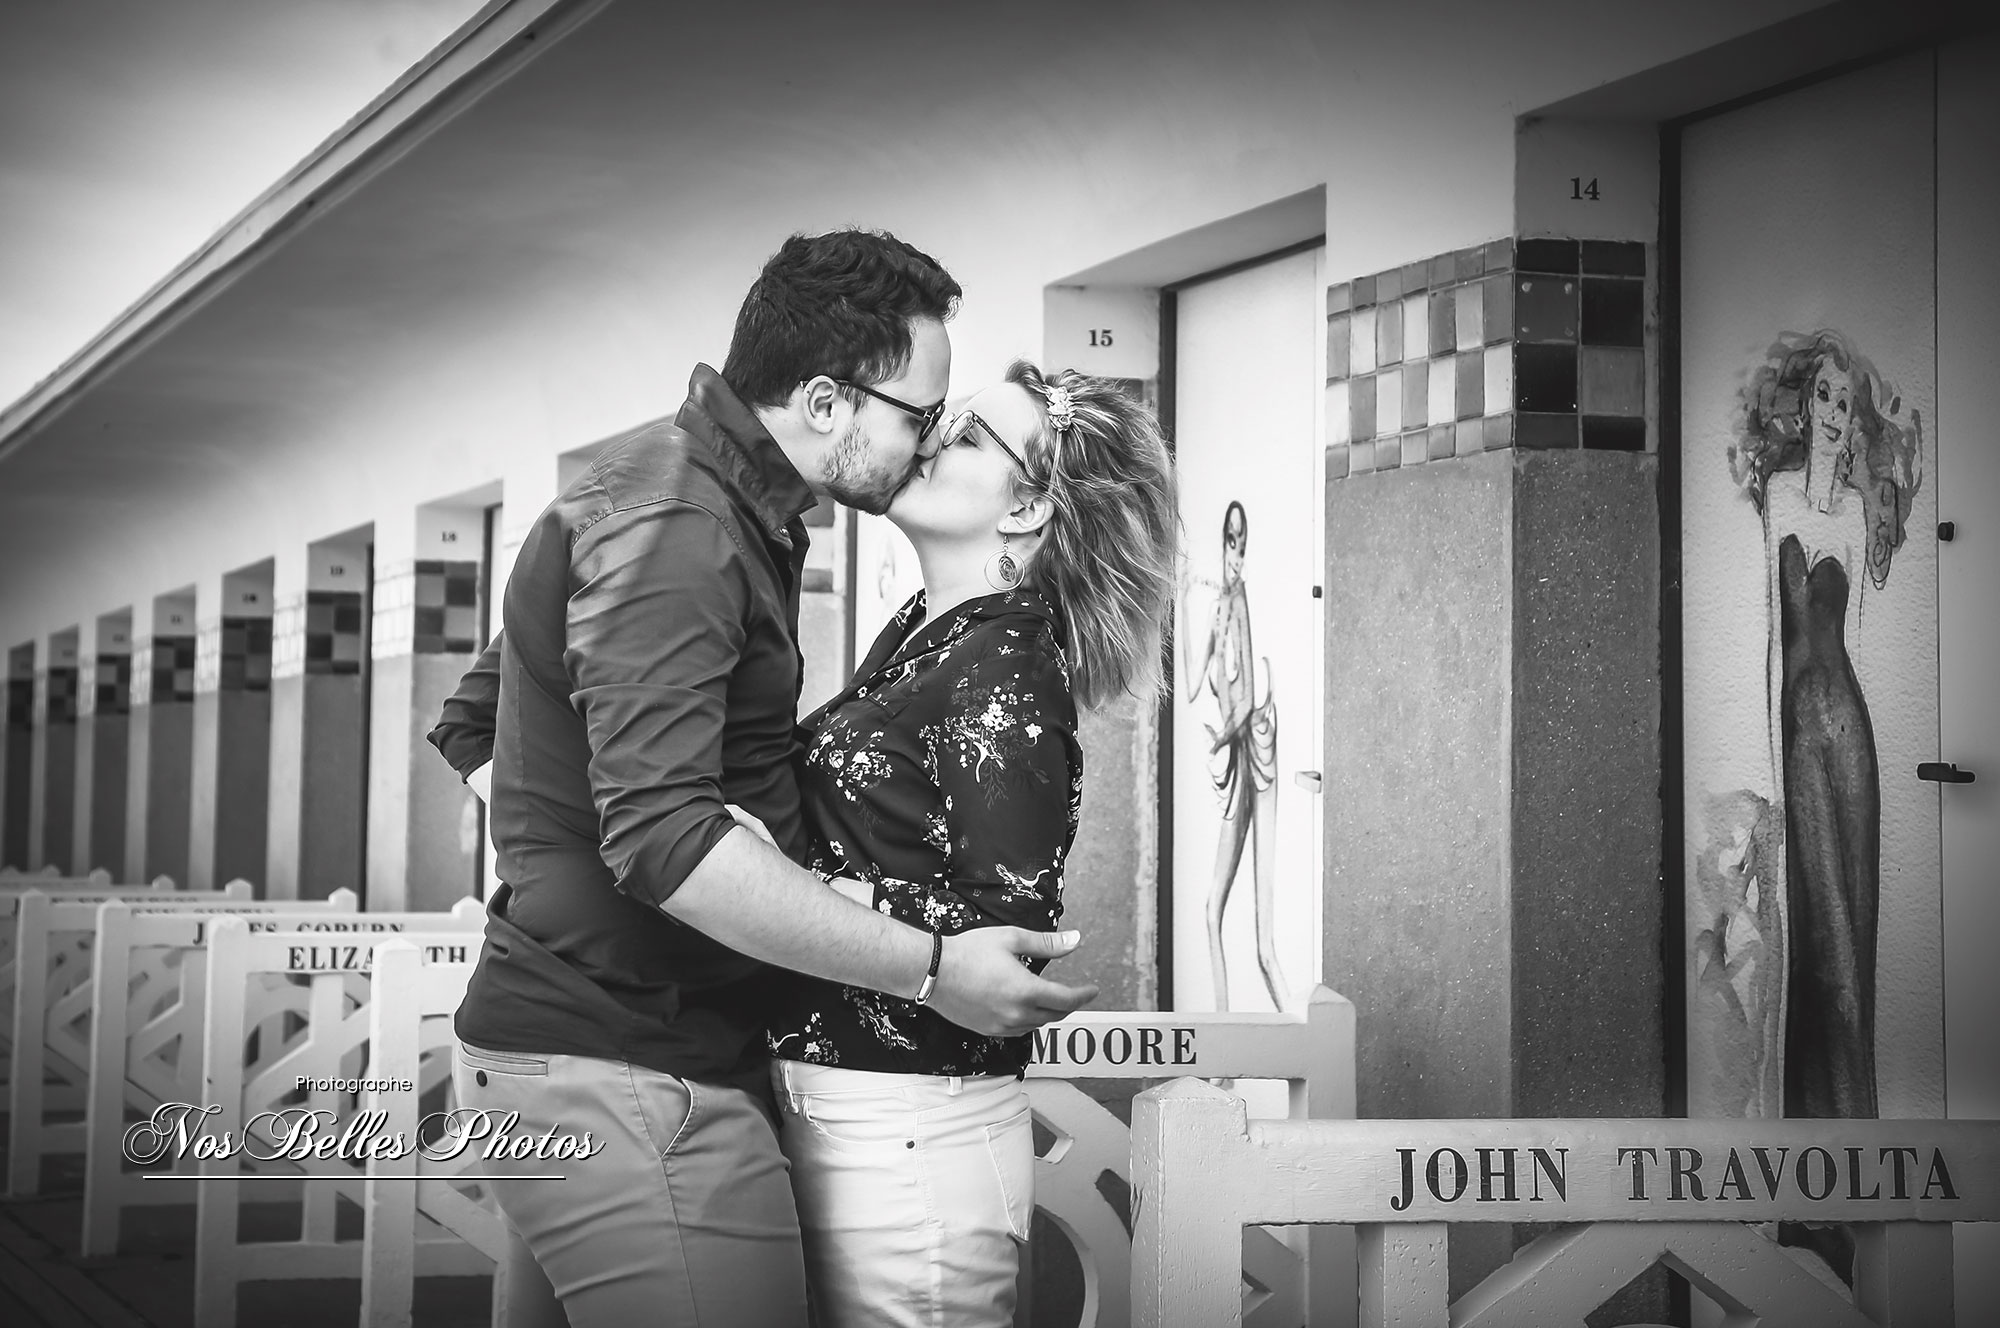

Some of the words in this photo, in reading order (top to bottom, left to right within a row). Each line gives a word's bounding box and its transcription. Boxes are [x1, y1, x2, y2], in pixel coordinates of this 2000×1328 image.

[1570, 177, 1600, 200] 14
[1088, 329, 1114, 347] 15
[1030, 1027, 1198, 1065] MOORE
[1390, 1148, 1570, 1211] JOHN
[1617, 1147, 1960, 1202] TRAVOLTA
